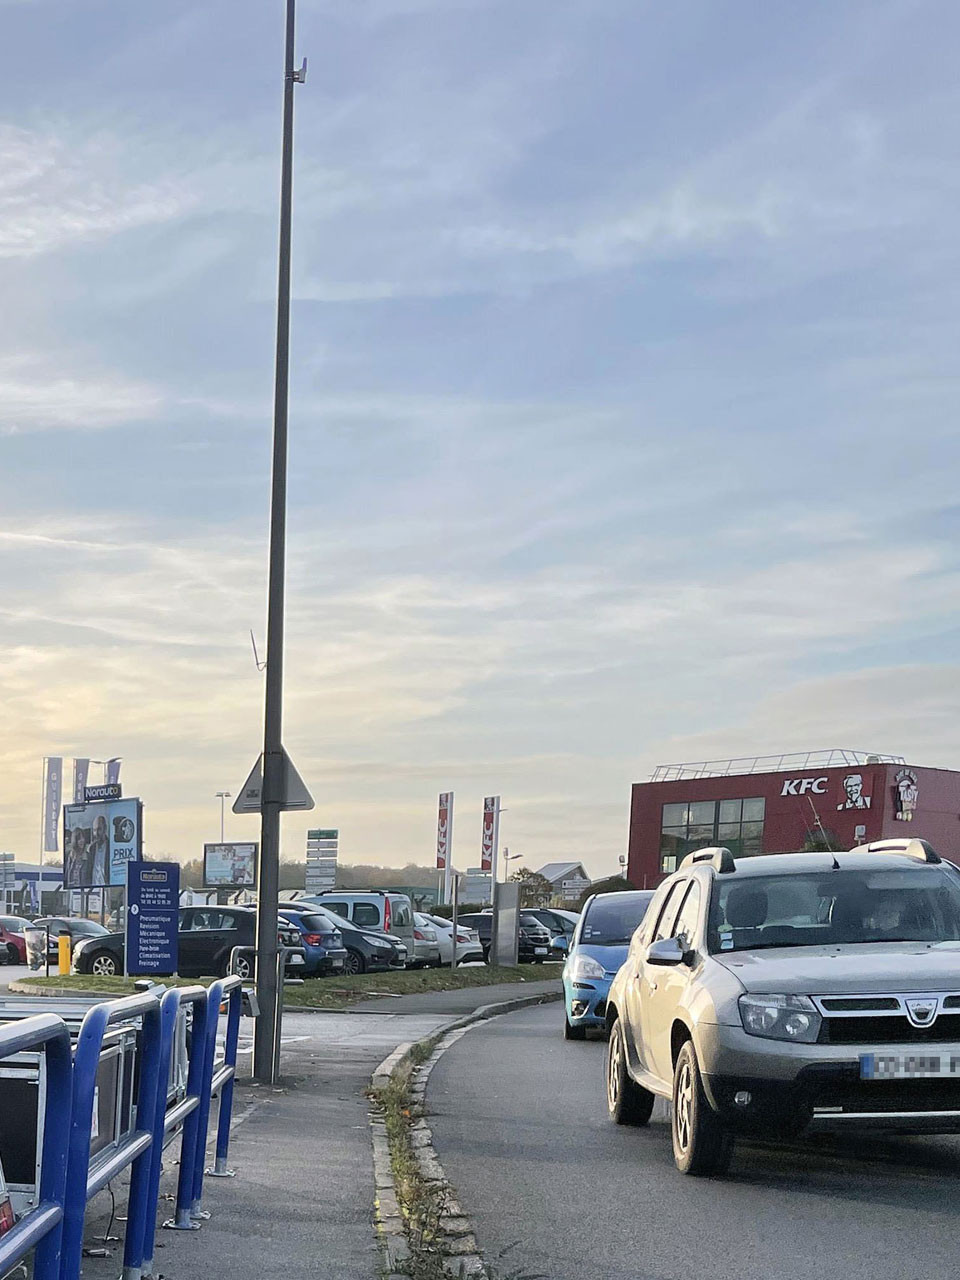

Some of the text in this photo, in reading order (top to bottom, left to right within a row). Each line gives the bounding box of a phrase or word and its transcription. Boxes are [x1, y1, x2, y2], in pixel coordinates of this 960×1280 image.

[85, 786, 119, 798] Norauto
[780, 777, 828, 796] KFC
[437, 819, 447, 860] KFC
[482, 822, 493, 862] KFC
[113, 847, 135, 858] PRIX
[140, 915, 171, 923] Pneumatique
[138, 960, 160, 968] Freinage
